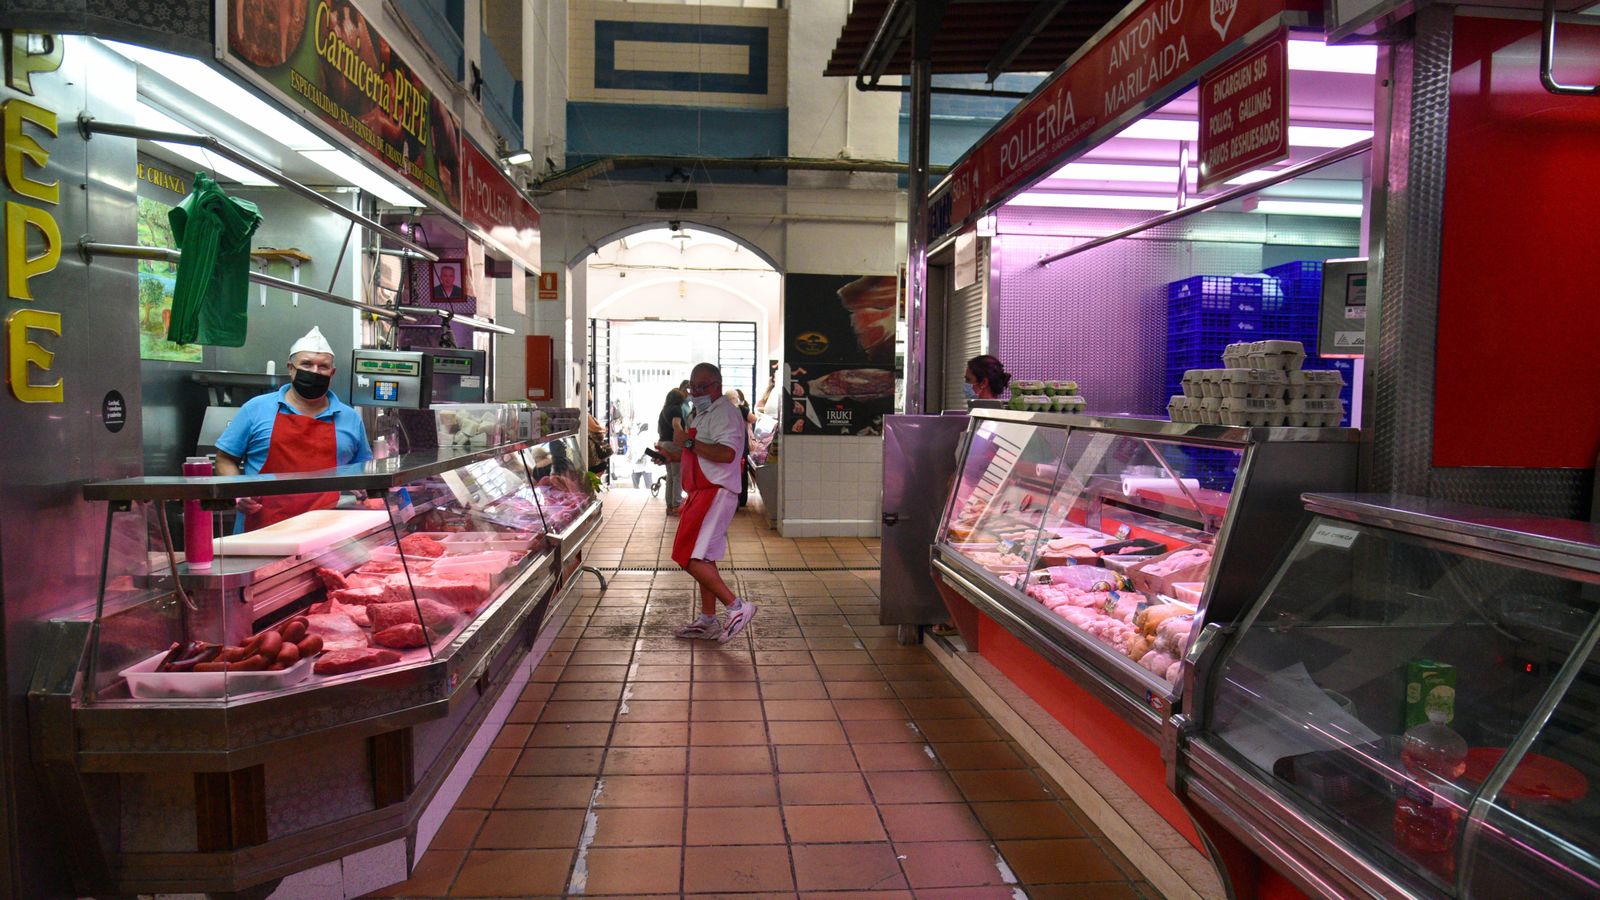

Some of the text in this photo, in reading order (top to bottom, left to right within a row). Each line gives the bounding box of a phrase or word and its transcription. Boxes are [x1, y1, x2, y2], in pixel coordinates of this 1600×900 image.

[1108, 0, 1184, 74] ANTONIO
[290, 70, 339, 120] ESPECIALIDAD
[340, 108, 349, 128] EN
[1104, 35, 1190, 117] MARILAIDA
[1213, 55, 1268, 104] ENCARGUEN SUS
[393, 69, 428, 145] PEPE
[1238, 86, 1272, 123] GALLINAS
[1000, 88, 1076, 178] POLLERÍA
[1209, 140, 1229, 168] PAVOS
[1230, 118, 1280, 159] DESHUESADOS
[147, 167, 186, 195] CRIANZA
[826, 410, 852, 420] IRUKI
